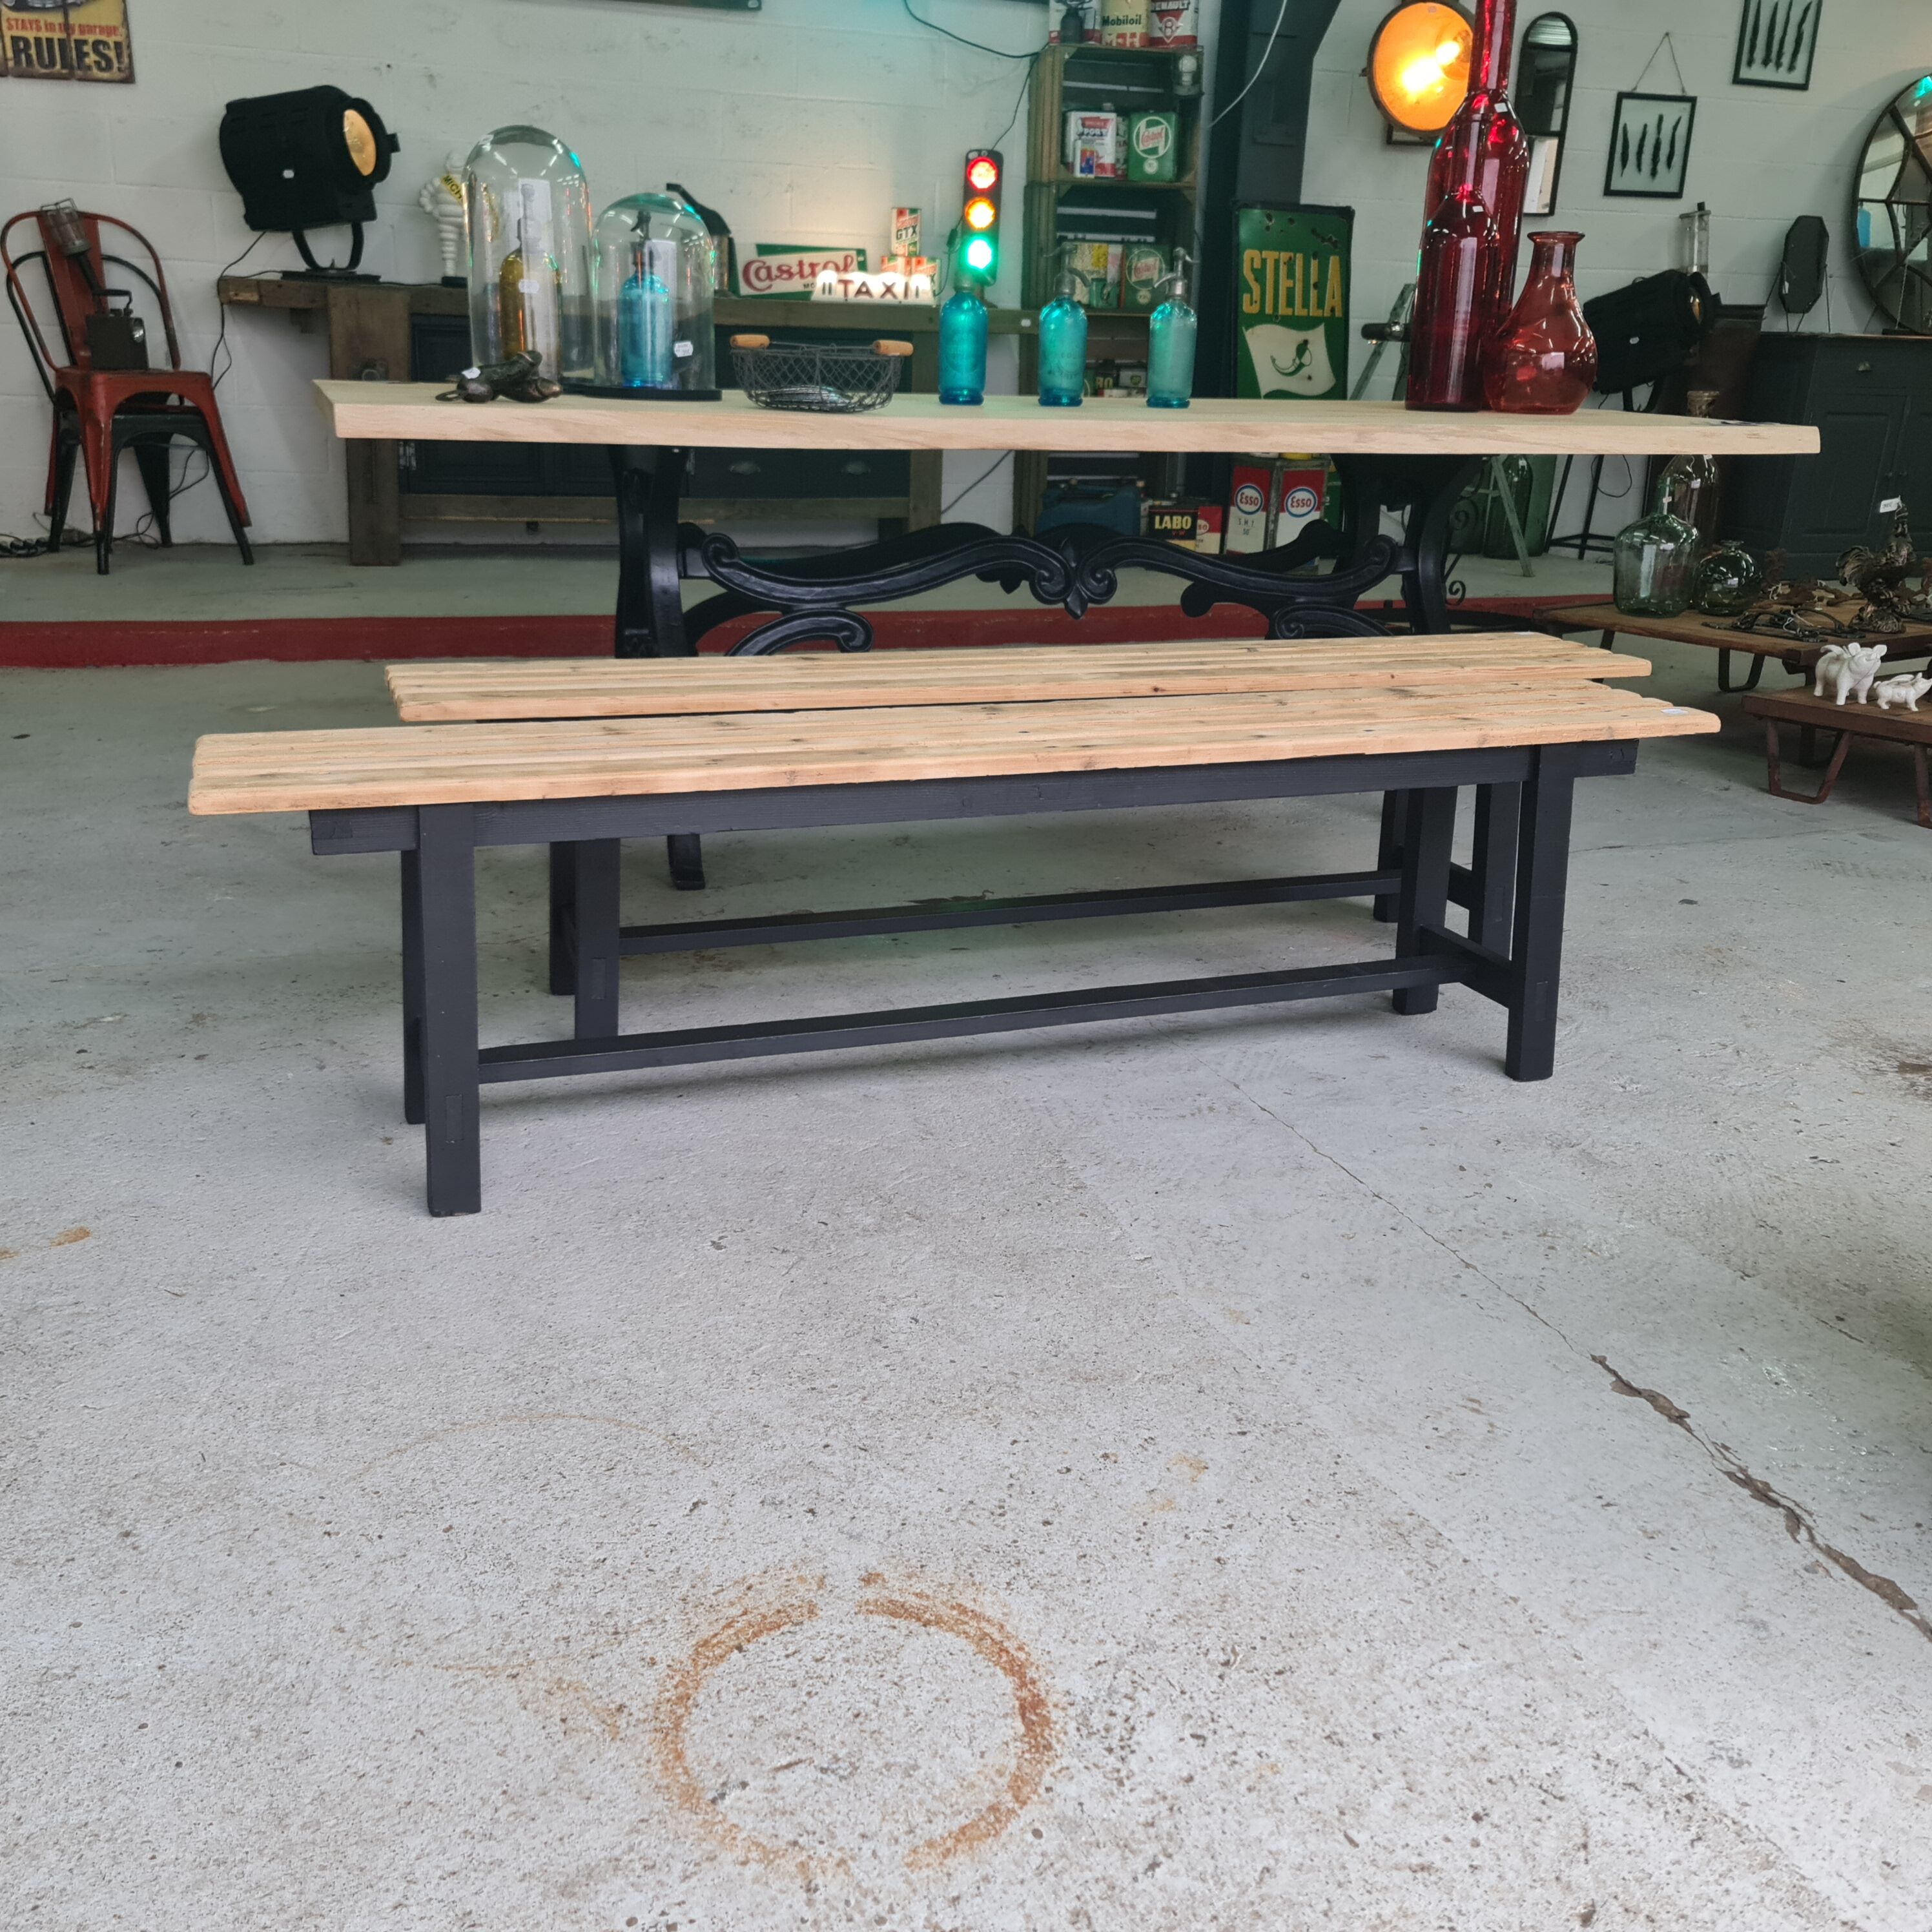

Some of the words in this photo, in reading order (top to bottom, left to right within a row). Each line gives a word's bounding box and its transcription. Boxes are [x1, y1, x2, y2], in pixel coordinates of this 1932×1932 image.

[6, 17, 43, 32] STAYS
[45, 20, 56, 32] in
[1102, 14, 1142, 26] Mobiloil
[10, 36, 125, 72] RULES!
[896, 224, 918, 240] GTX
[743, 255, 854, 292] Castrol
[1243, 249, 1342, 317] STELLA
[838, 278, 910, 300] TAXI
[1155, 515, 1192, 529] LABO
